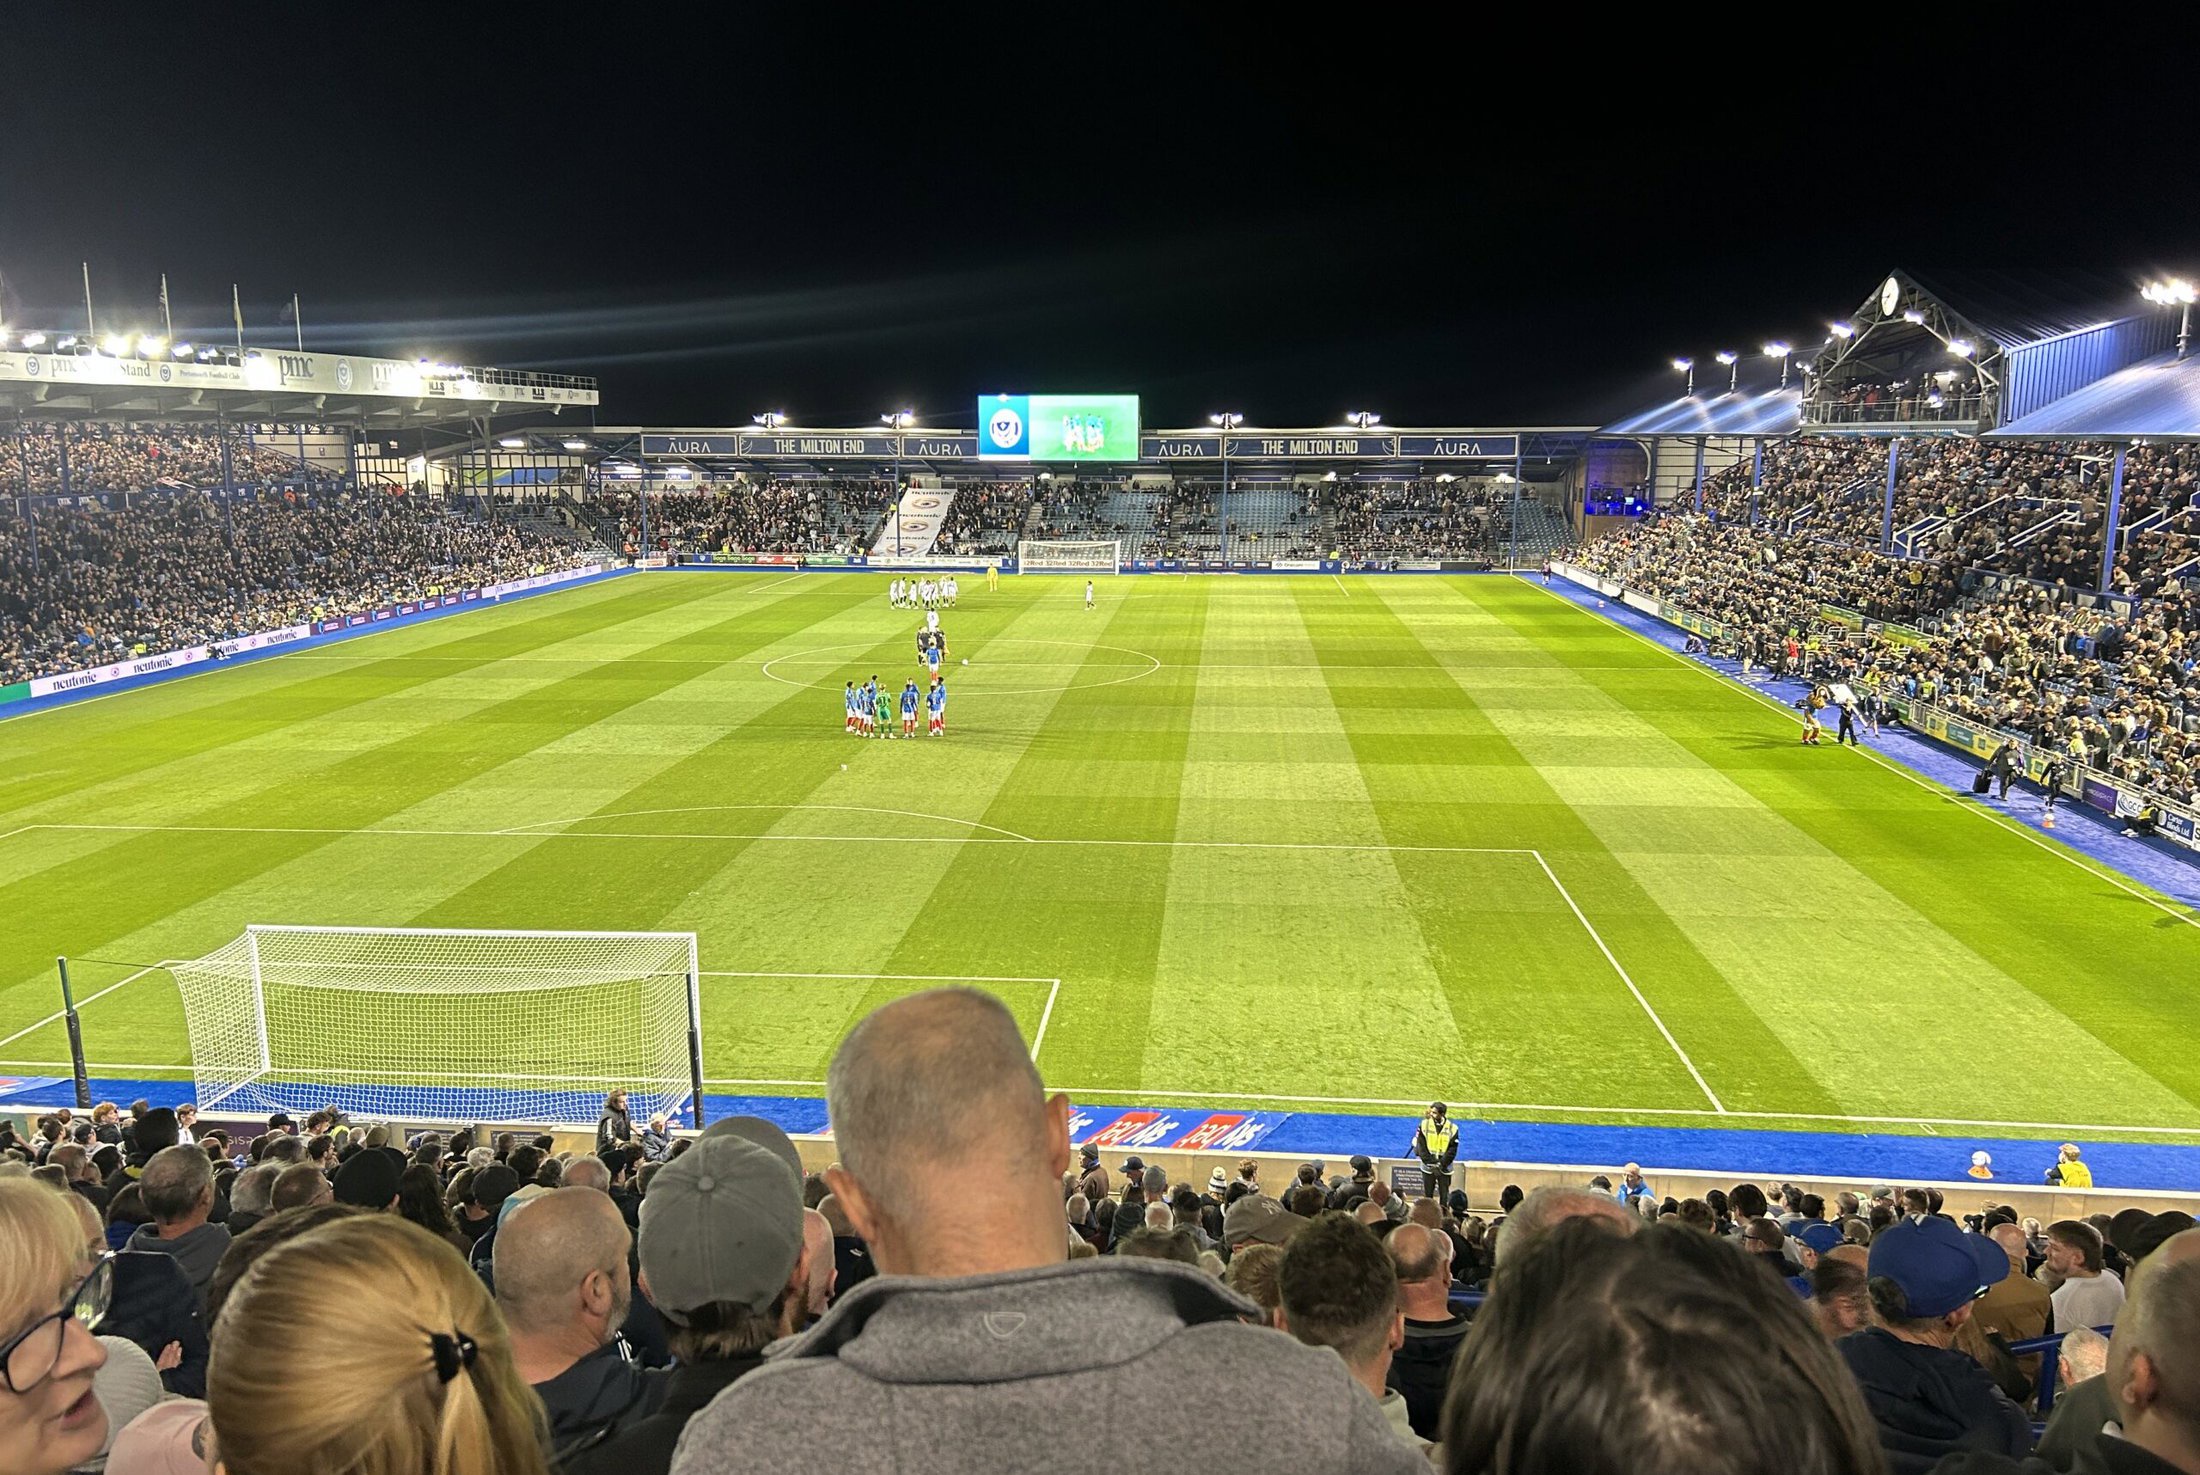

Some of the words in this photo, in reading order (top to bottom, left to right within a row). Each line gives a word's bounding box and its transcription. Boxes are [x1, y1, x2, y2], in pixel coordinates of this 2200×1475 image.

[278, 355, 315, 386] pmc
[774, 439, 796, 454] THE
[800, 439, 842, 454] MILTON
[843, 439, 865, 454] END
[1261, 439, 1284, 455] THE
[1289, 439, 1334, 455] MILTON
[1335, 439, 1359, 455] END
[133, 655, 173, 674] neutonic
[53, 672, 97, 691] neutonic
